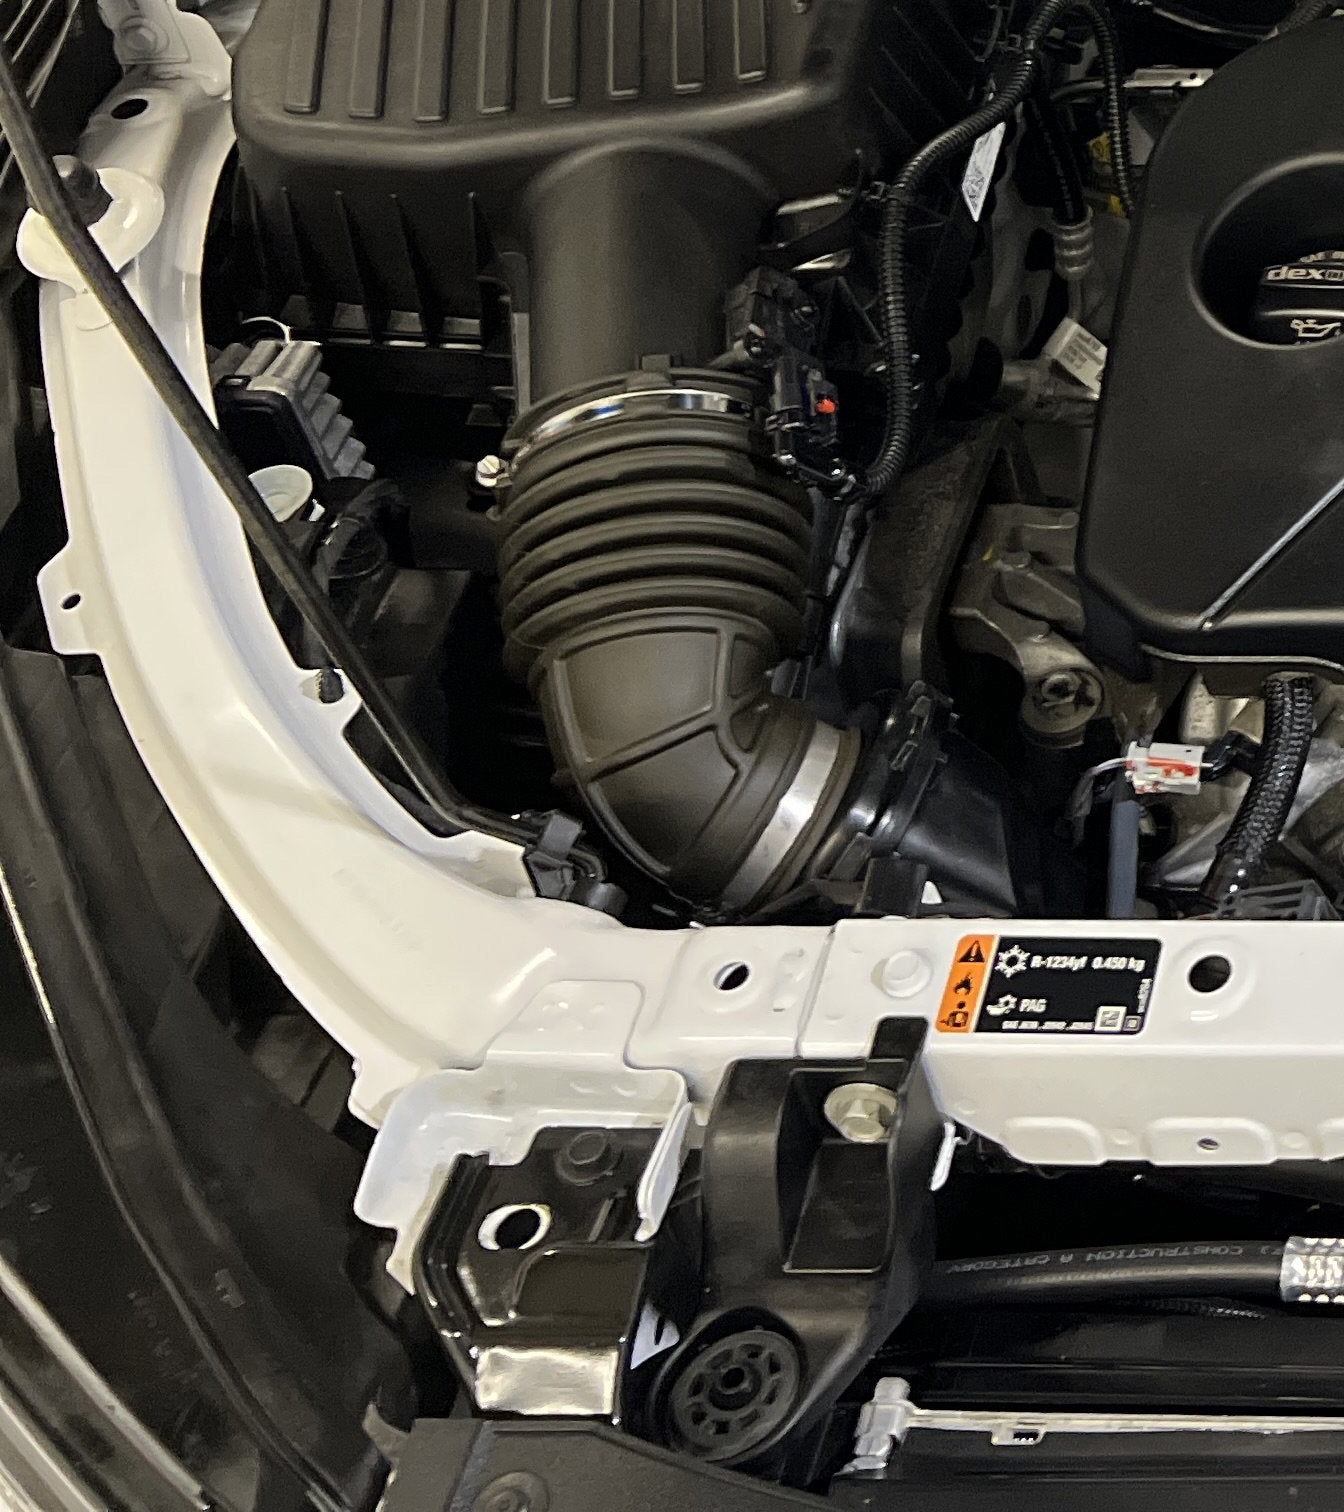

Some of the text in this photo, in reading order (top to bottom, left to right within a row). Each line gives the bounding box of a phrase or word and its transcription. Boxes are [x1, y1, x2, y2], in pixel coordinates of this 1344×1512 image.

[1030, 955, 1088, 971] R-1234yf
[1127, 957, 1146, 973] kg
[1019, 999, 1048, 1013] PAG
[1085, 1244, 1244, 1262] CONSTRUCTION
